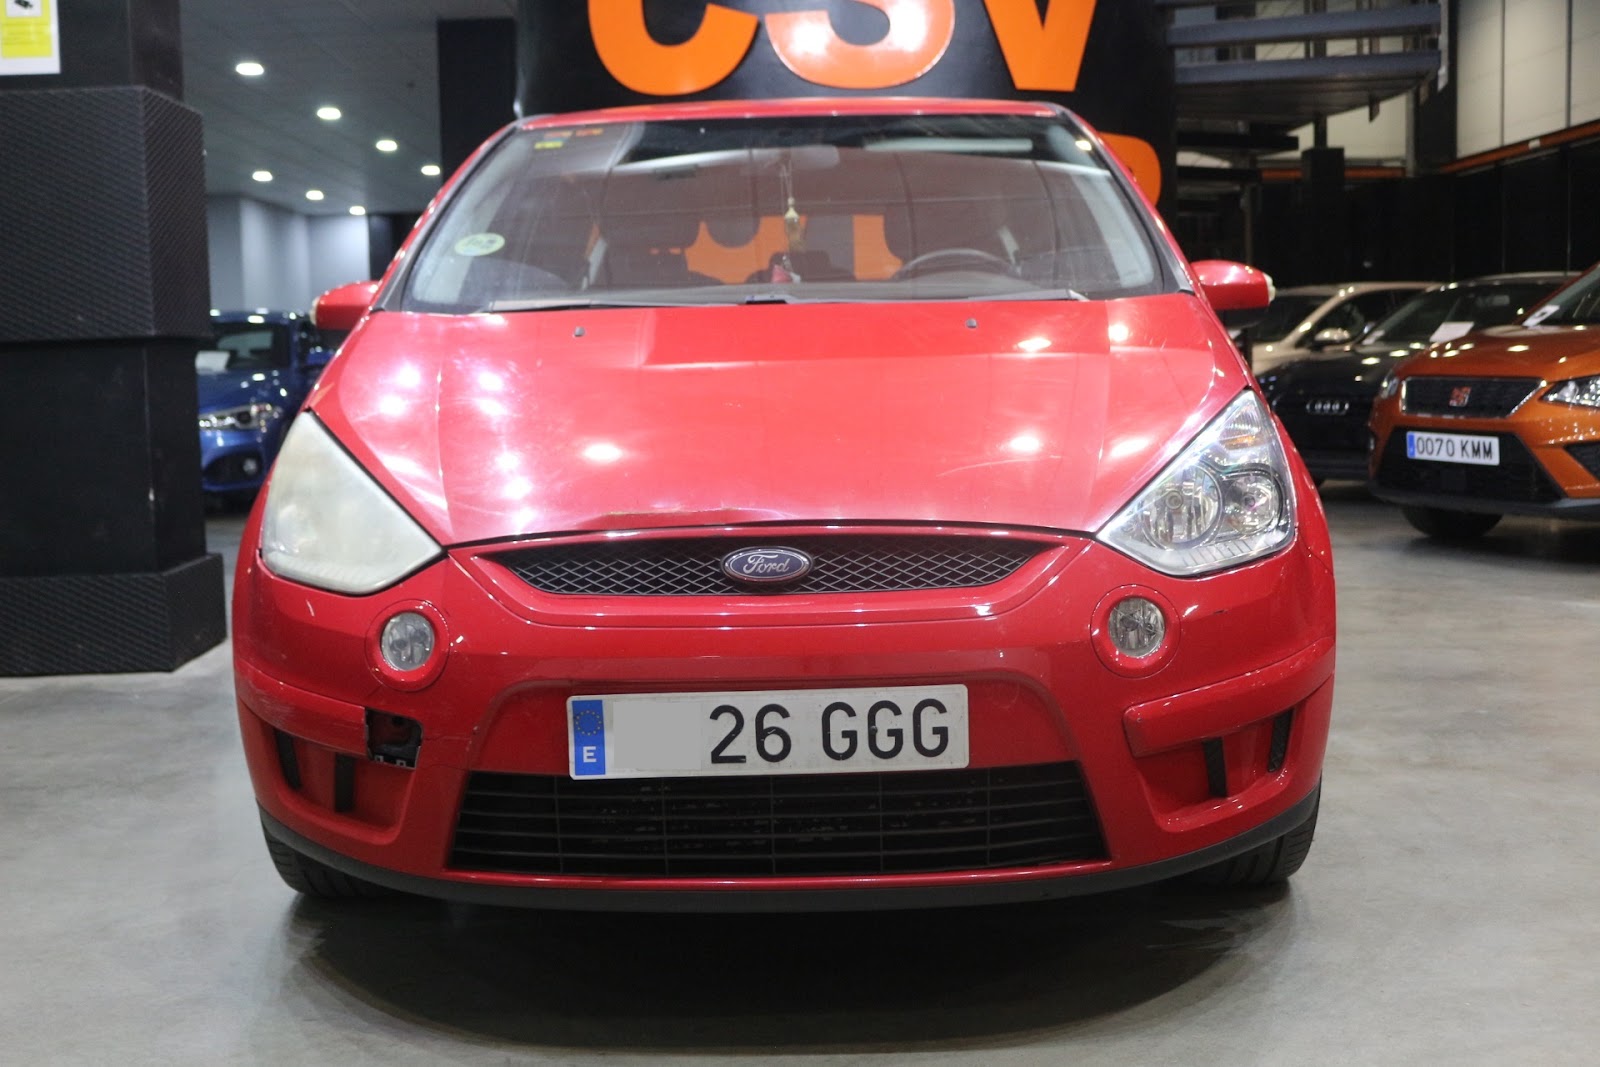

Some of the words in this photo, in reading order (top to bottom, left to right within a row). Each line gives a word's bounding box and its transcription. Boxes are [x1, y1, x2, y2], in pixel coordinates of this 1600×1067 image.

[1416, 436, 1455, 457] 0070
[1460, 440, 1493, 460] KMM
[742, 554, 790, 574] Ford
[821, 698, 949, 761] GGG
[583, 746, 597, 763] E
